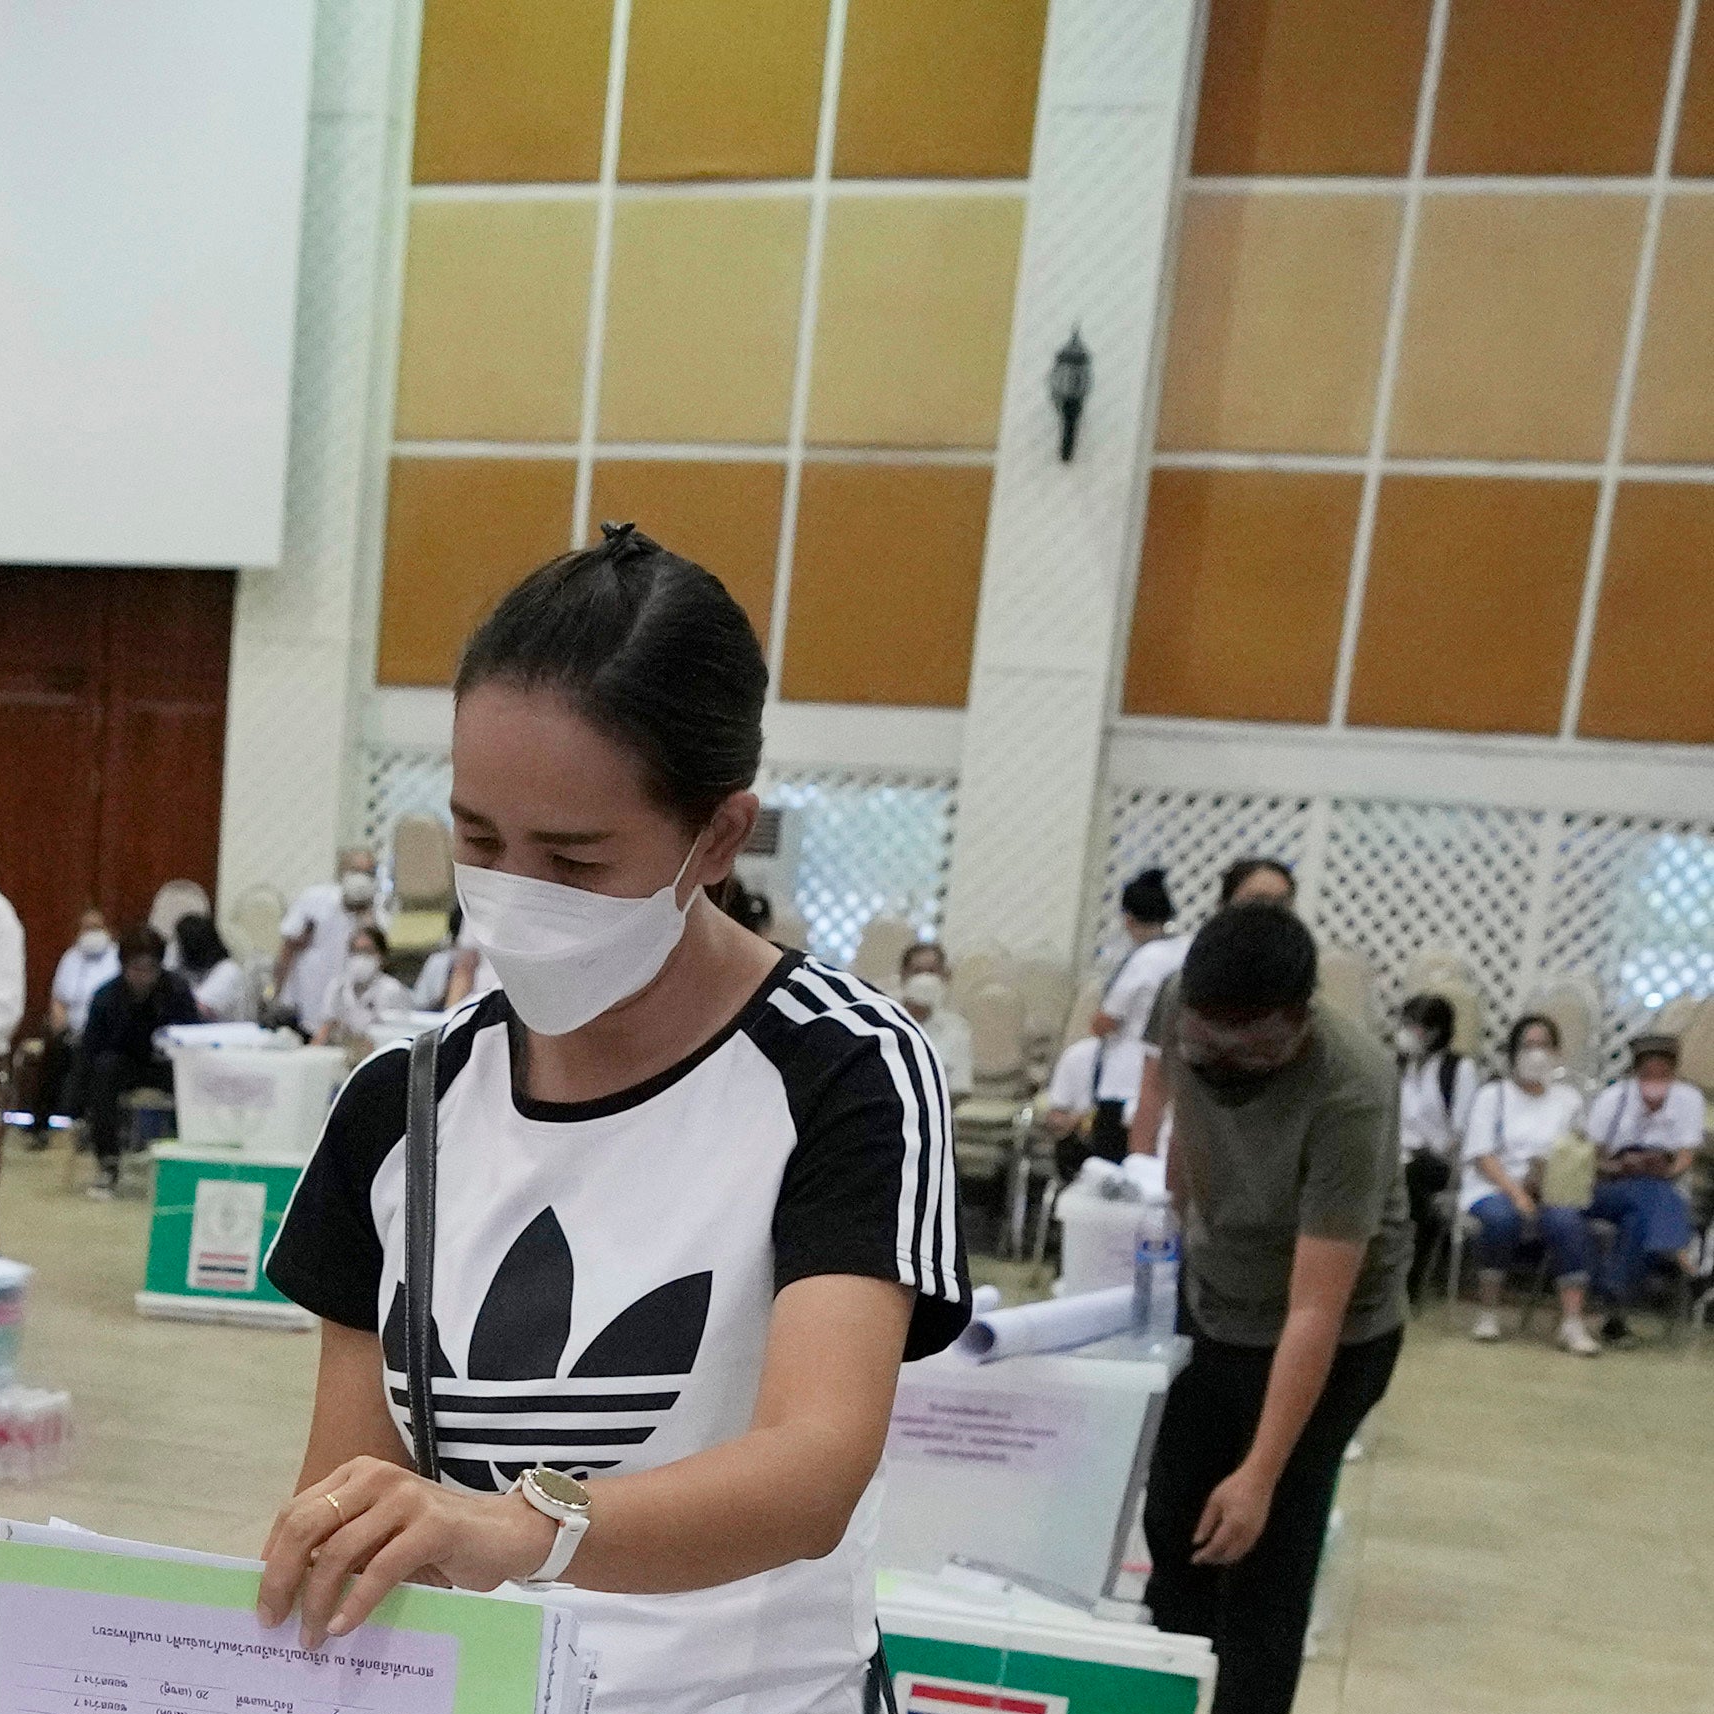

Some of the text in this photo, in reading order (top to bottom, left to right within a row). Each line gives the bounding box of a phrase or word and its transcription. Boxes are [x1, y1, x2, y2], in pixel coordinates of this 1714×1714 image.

[334, 1656, 345, 1666] ณ
[351, 1657, 434, 1679] สถานที่เลือกตั้ง
[196, 1689, 209, 1700] 20
